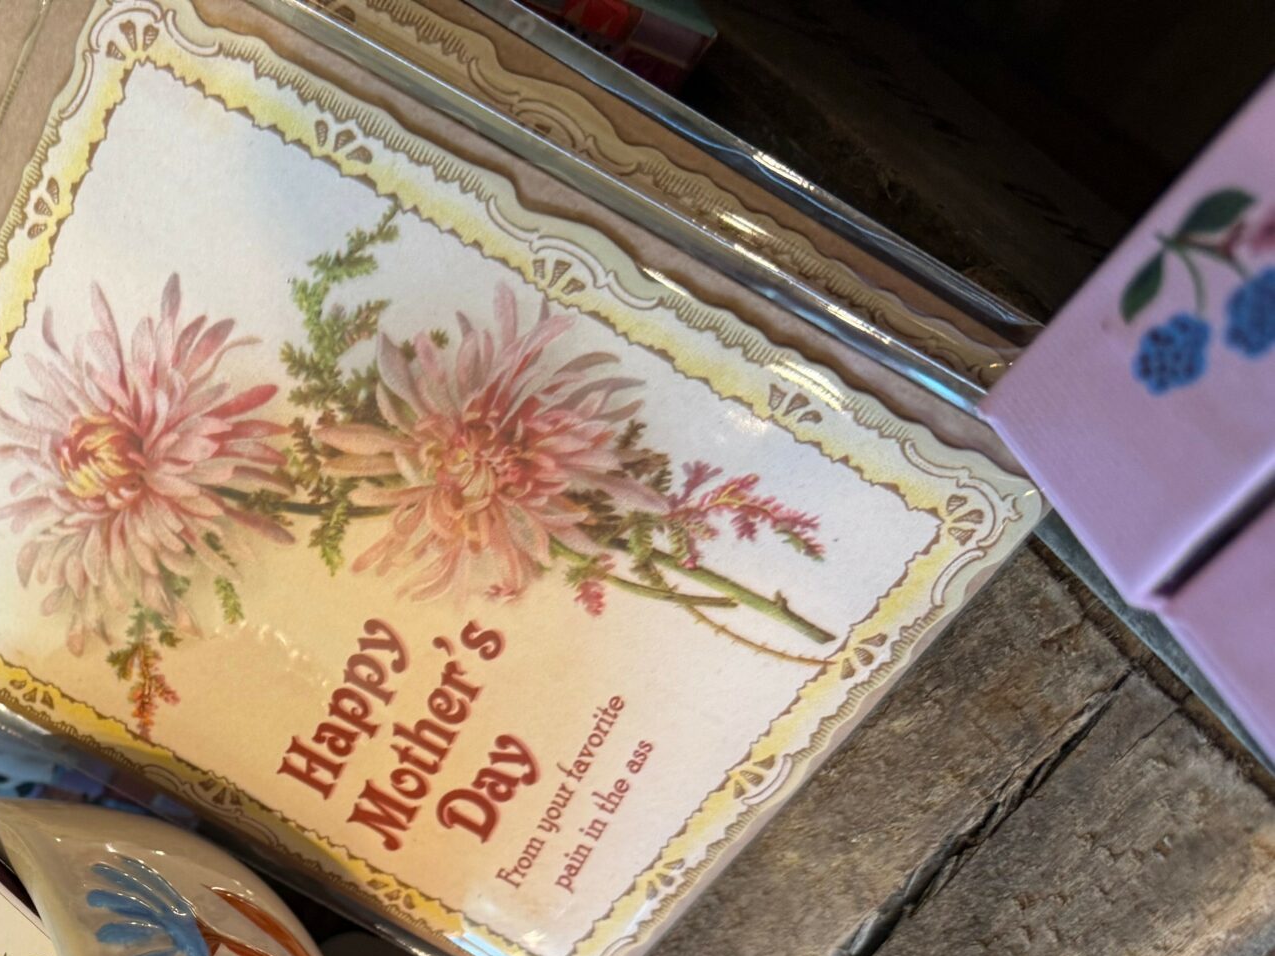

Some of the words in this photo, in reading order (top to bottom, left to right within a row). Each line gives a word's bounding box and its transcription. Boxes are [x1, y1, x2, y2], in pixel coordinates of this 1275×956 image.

[276, 618, 408, 800] Happy
[346, 619, 507, 851] Mother's
[436, 733, 540, 843] Day
[496, 836, 548, 890] From
[534, 782, 579, 834] your
[557, 694, 626, 781] favorite
[591, 778, 631, 814] the
[623, 739, 655, 775] ass
[551, 843, 595, 894] pain
[578, 817, 608, 842] in
